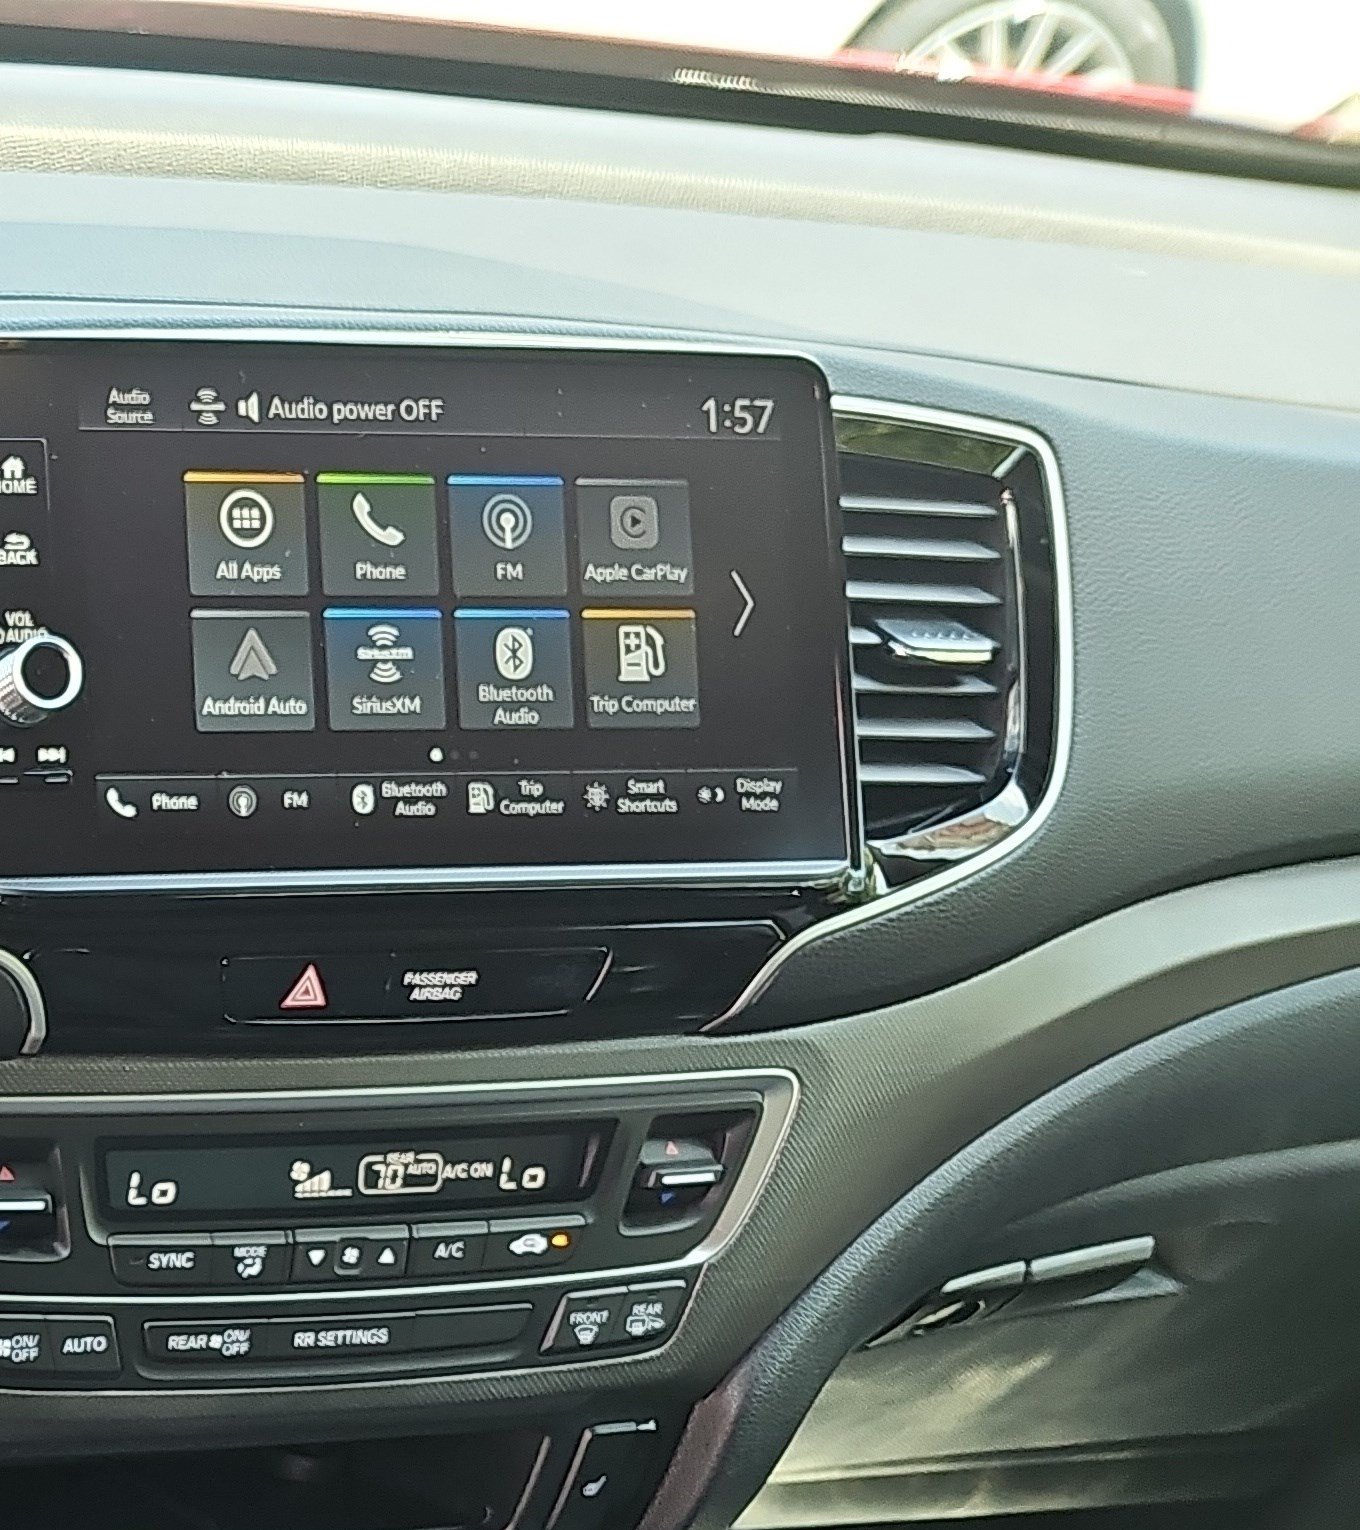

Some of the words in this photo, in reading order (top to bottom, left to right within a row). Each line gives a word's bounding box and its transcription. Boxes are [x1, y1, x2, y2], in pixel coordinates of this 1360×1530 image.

[108, 388, 151, 405] Audio
[107, 408, 154, 425] Source
[268, 395, 328, 420] Audio
[332, 401, 396, 424] power
[400, 399, 444, 421] OFF
[701, 396, 775, 434] 1:57
[216, 562, 238, 579] All
[241, 562, 282, 583] Apps
[355, 561, 407, 581] Phone
[496, 563, 524, 581] FM
[584, 563, 627, 584] Apple
[631, 563, 689, 584] CarPlay
[4, 610, 34, 627] VOL
[478, 684, 554, 702] Bluetooth
[202, 697, 264, 716] Android
[268, 697, 308, 716] Auto
[352, 694, 422, 714] SiriusXM
[591, 697, 618, 715] Trip
[621, 697, 696, 715] Computer
[494, 708, 540, 726] Audio
[381, 781, 448, 798] Bluetooth
[518, 780, 544, 798] Trip
[627, 779, 666, 796] Smart
[736, 777, 782, 797] Display
[152, 793, 199, 811] Phone
[283, 791, 309, 808] FM
[394, 800, 436, 817] Audio
[500, 799, 565, 816] Computer
[617, 797, 678, 814] Shortcuts
[741, 796, 780, 812] Mode
[402, 970, 478, 986] PASSENGER
[408, 986, 463, 1001] AIRBAG
[371, 1163, 406, 1191] 70
[406, 1161, 438, 1175] AUTO
[441, 1161, 469, 1179] A/C
[469, 1161, 495, 1179] ON
[498, 1155, 547, 1190] Lo
[127, 1170, 179, 1207] Lo
[233, 1246, 267, 1259] MODE
[433, 1241, 466, 1260] A/C
[147, 1252, 196, 1270] SYNC
[569, 1310, 610, 1326] FRONT
[632, 1302, 664, 1317] REAR
[11, 1334, 40, 1349] ON/
[62, 1336, 109, 1354] AUTO
[167, 1335, 207, 1352] REAR
[223, 1329, 252, 1343] ON/
[293, 1332, 316, 1348] RR
[316, 1328, 390, 1347] SETTINGS
[11, 1348, 40, 1363] OFF
[221, 1342, 250, 1356] OFF
